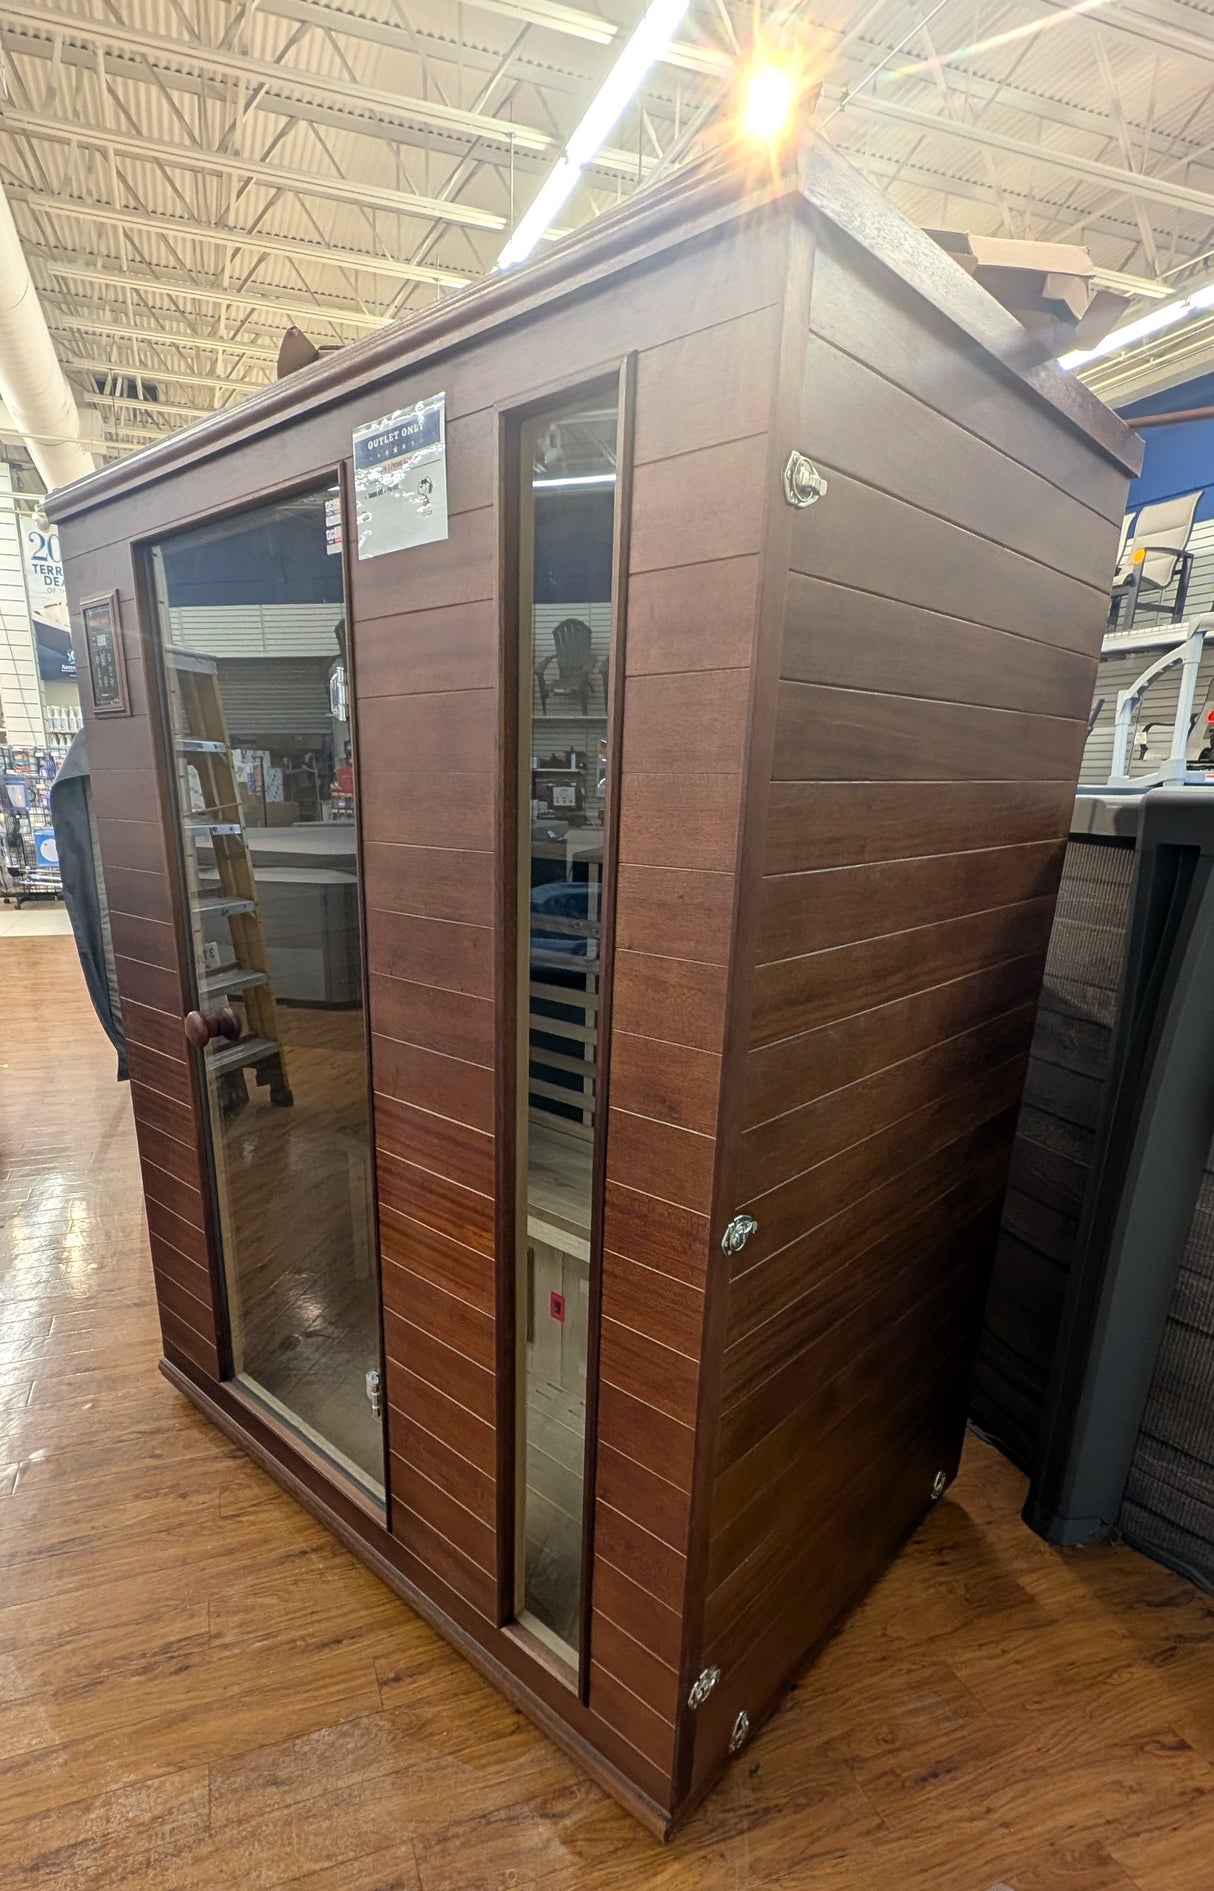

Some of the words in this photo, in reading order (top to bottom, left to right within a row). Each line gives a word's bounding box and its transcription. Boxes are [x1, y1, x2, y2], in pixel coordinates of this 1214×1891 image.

[368, 431, 399, 449] OUTLET
[401, 424, 423, 437] ONLY
[32, 563, 63, 576] TERR
